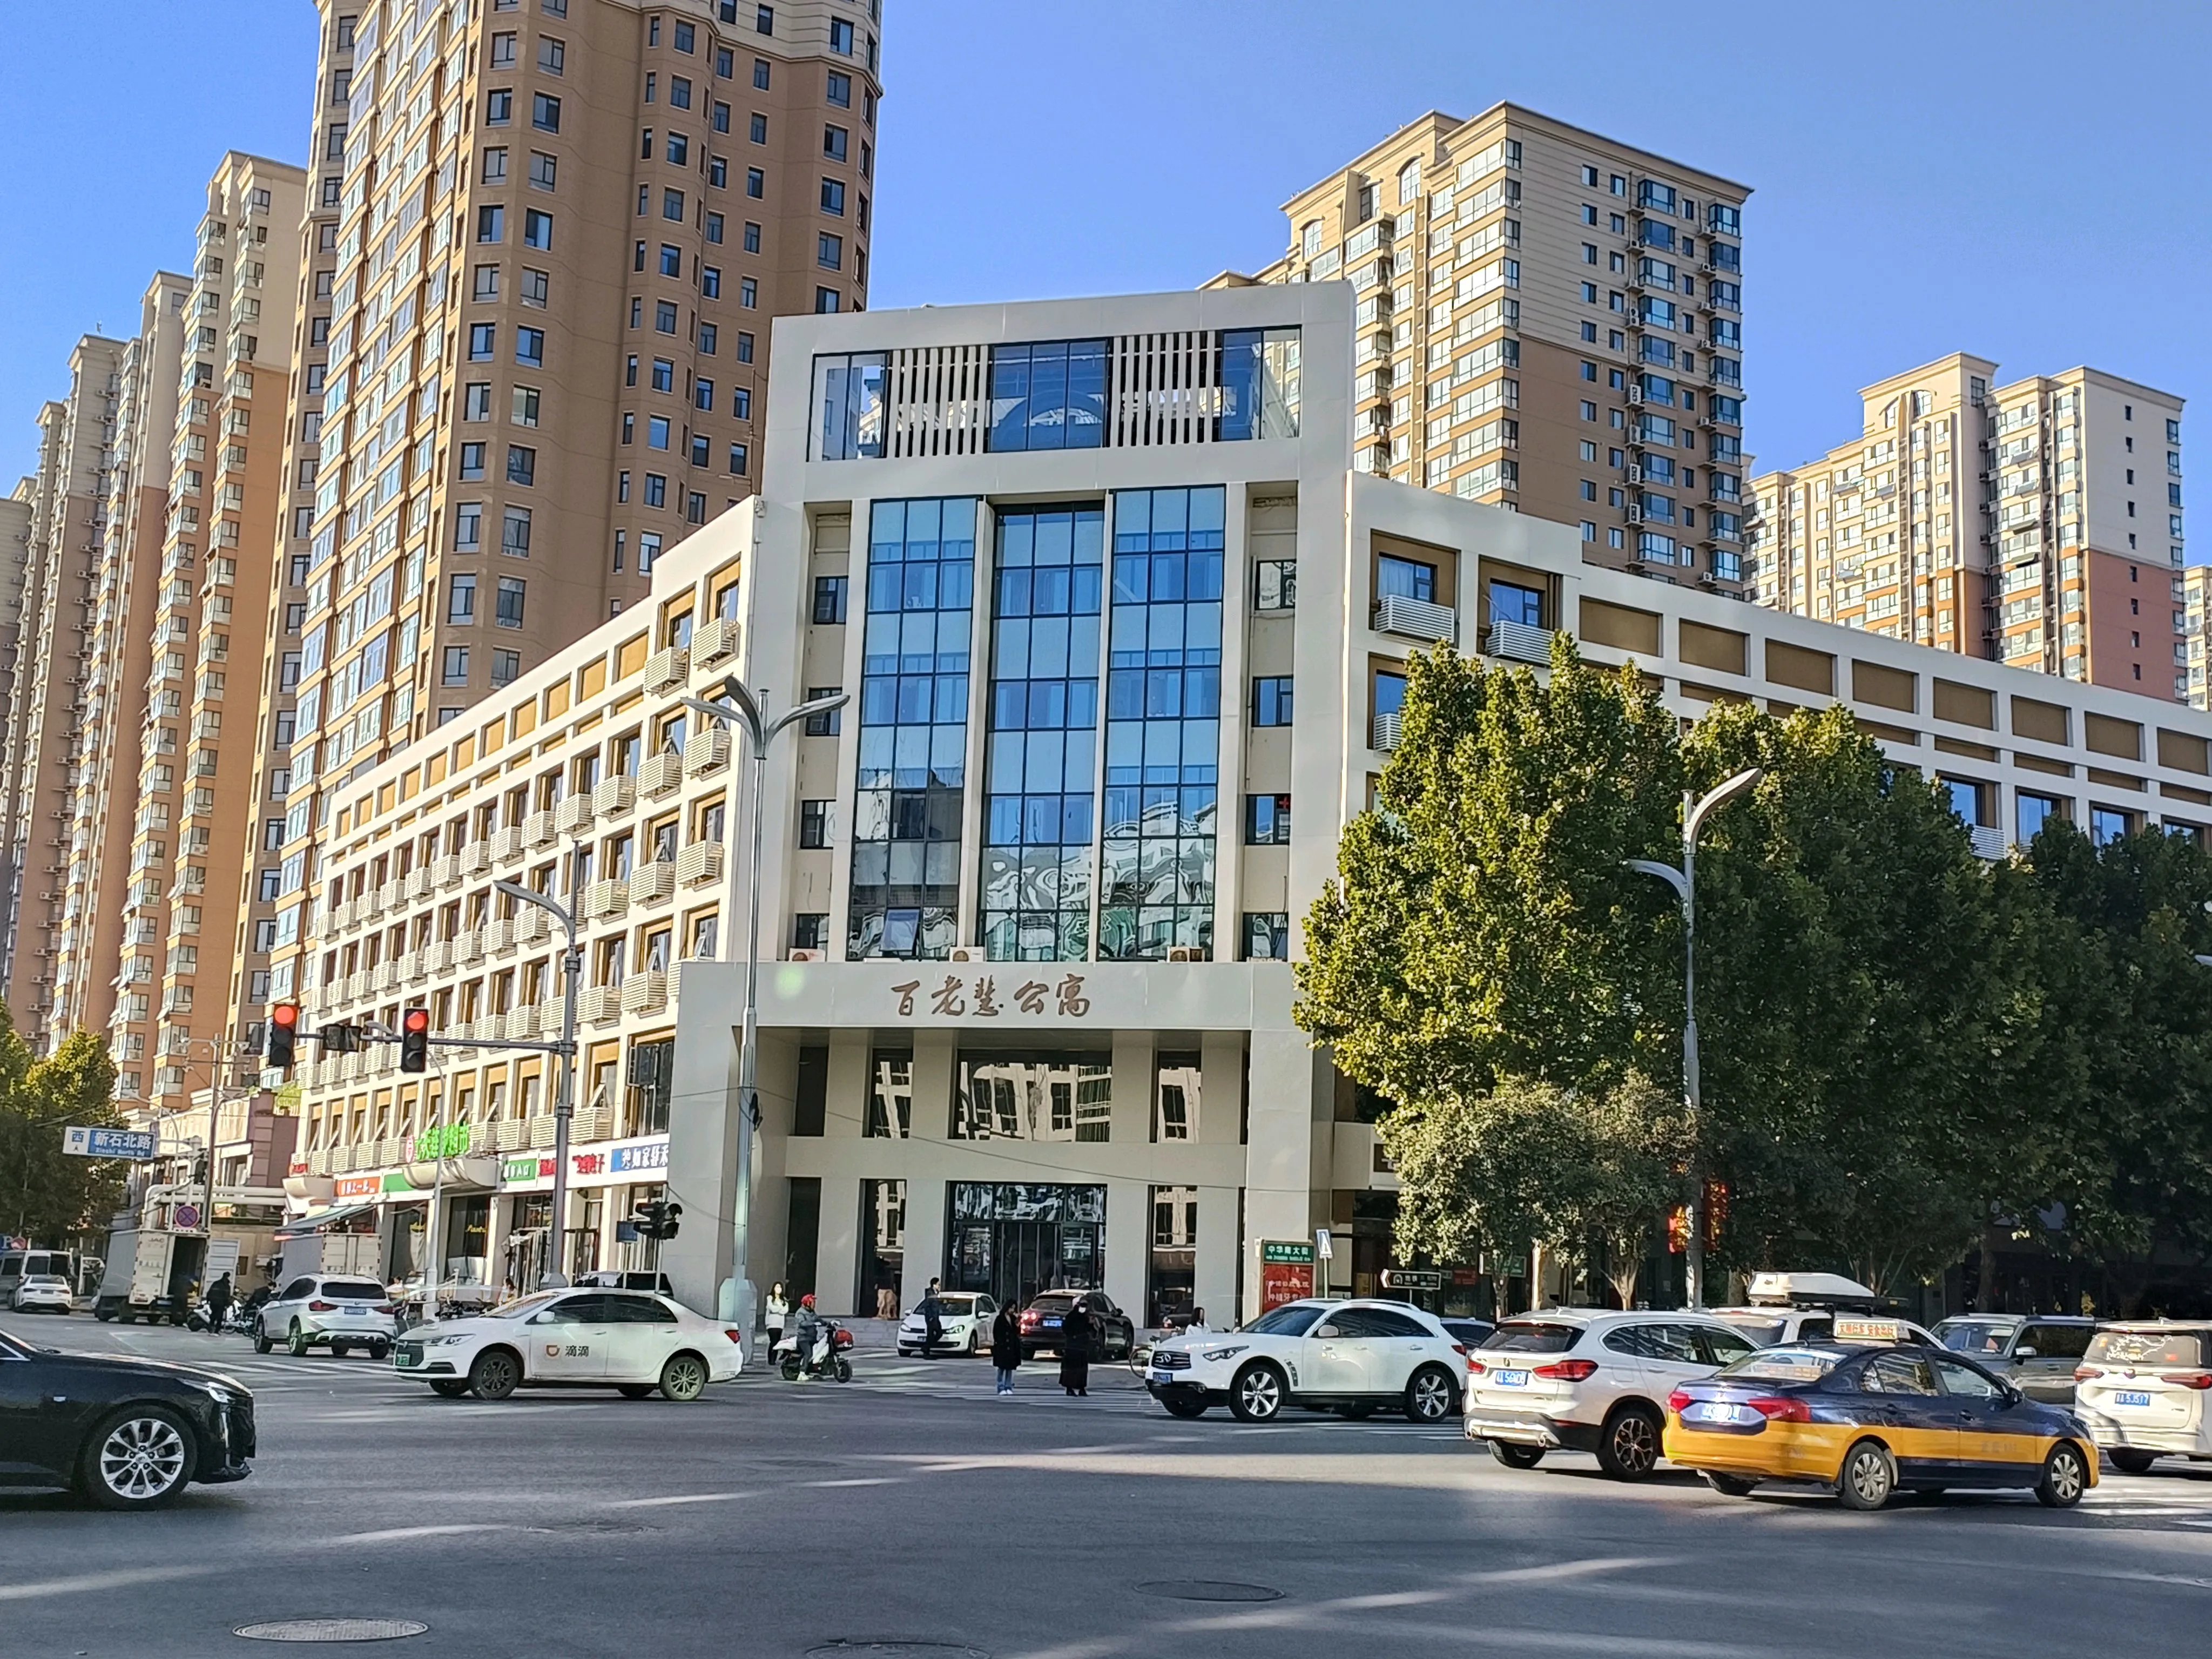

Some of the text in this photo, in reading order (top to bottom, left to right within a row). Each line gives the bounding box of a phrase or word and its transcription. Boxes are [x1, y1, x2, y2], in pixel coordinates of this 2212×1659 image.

[891, 973, 1090, 1017] 百老慧公寓
[72, 1130, 85, 1143] 西
[95, 1132, 151, 1150] 新石北路
[565, 1345, 589, 1357] 滴滴
